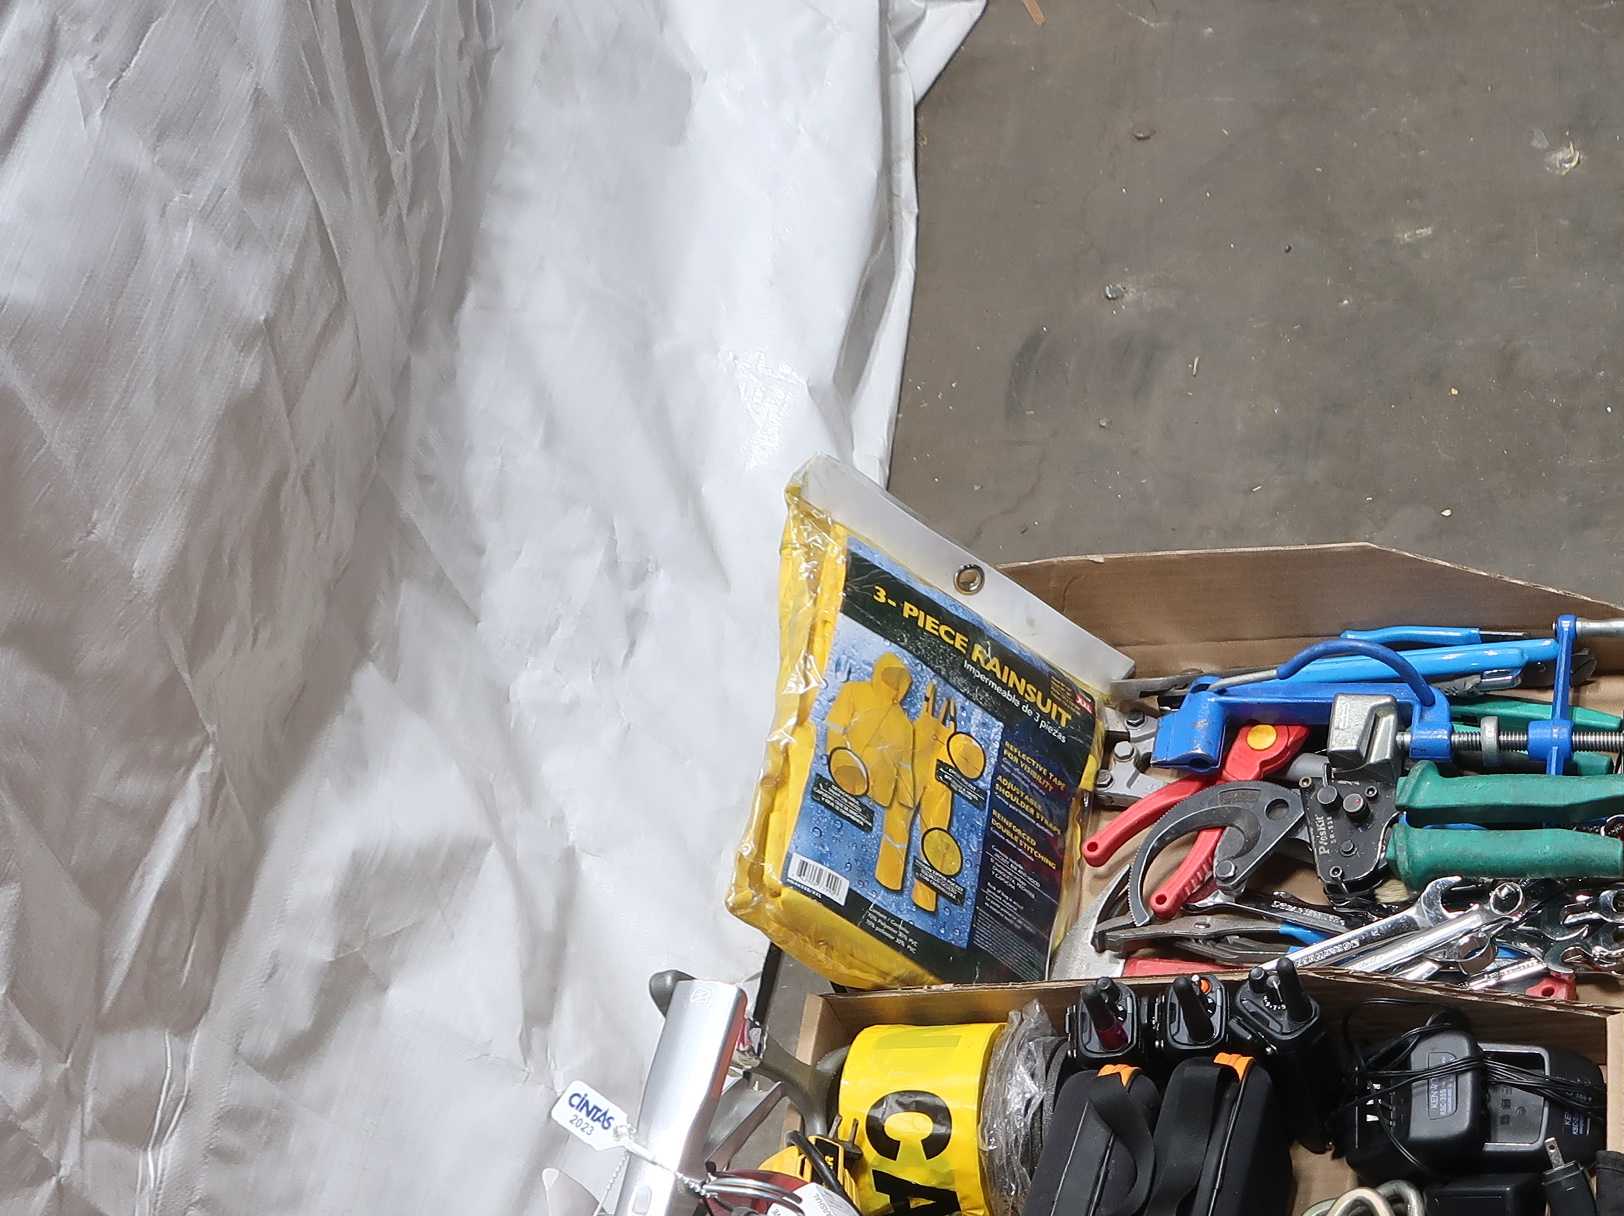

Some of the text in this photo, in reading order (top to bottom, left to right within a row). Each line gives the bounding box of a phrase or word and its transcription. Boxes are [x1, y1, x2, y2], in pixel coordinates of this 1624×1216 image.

[902, 600, 969, 655] PIECE
[971, 643, 1073, 728] RAINSUIT
[963, 660, 1021, 709] Impermeable
[1021, 703, 1034, 717] de
[1039, 719, 1067, 744] piezas
[569, 1114, 594, 1136] 2023
